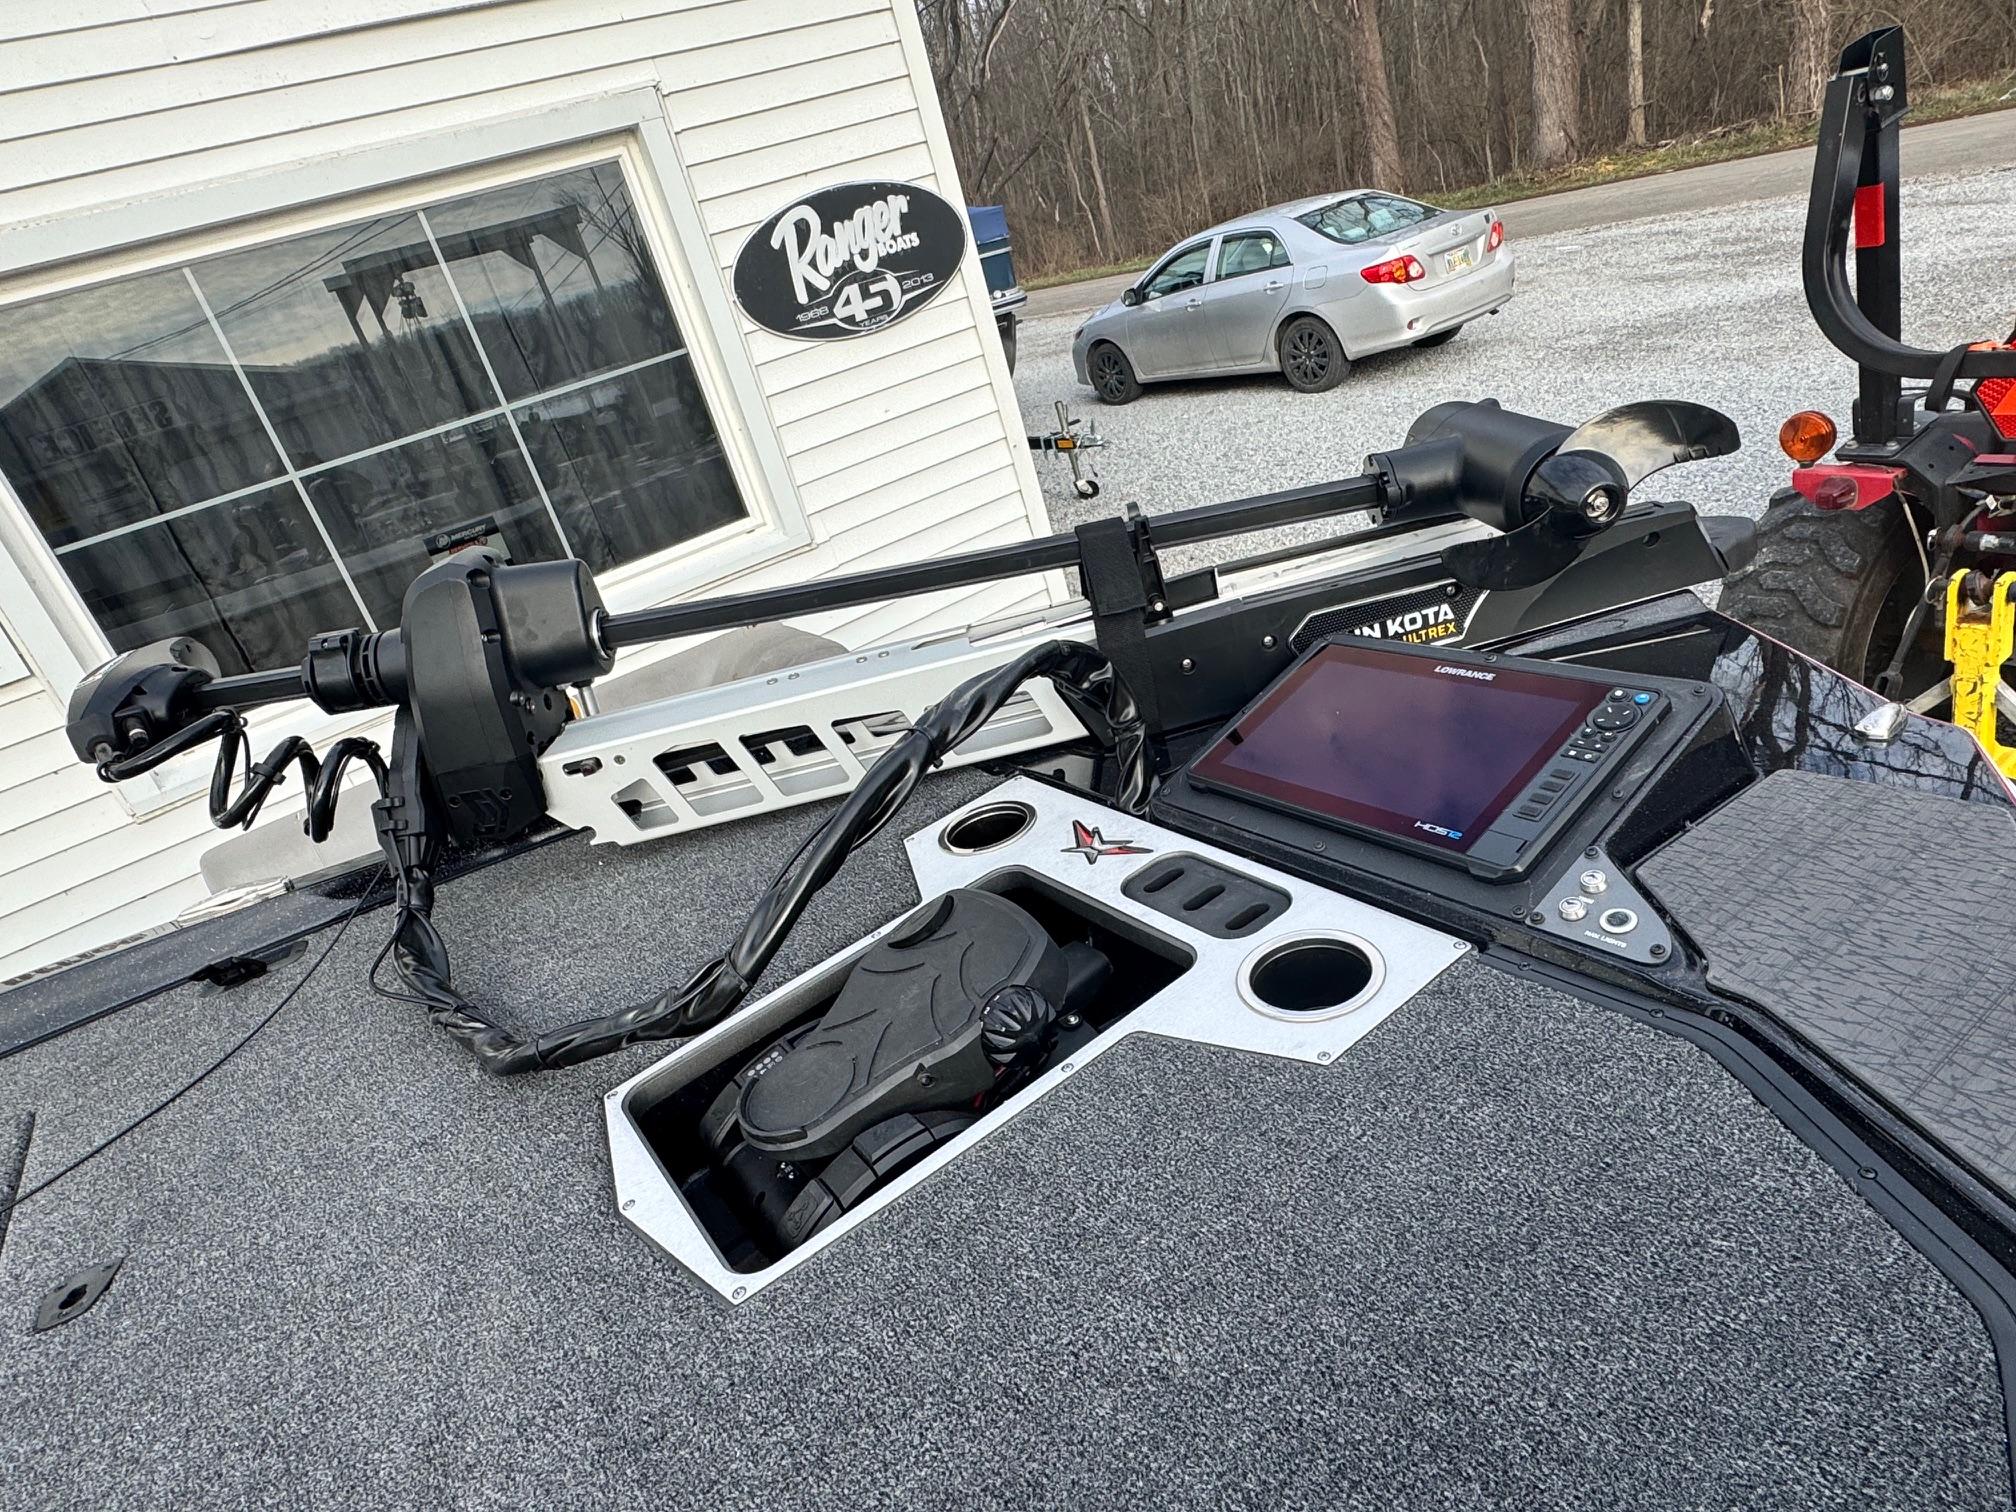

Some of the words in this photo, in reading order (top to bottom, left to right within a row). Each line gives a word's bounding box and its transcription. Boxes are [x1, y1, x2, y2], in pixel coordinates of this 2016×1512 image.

[770, 194, 909, 305] Ranger
[876, 231, 921, 257] BOATS
[833, 274, 901, 323] 45
[902, 272, 935, 290] 2013
[1386, 603, 1455, 637] KOTA
[1403, 622, 1457, 643] ULTREX
[1434, 665, 1496, 682] LOWRANCE
